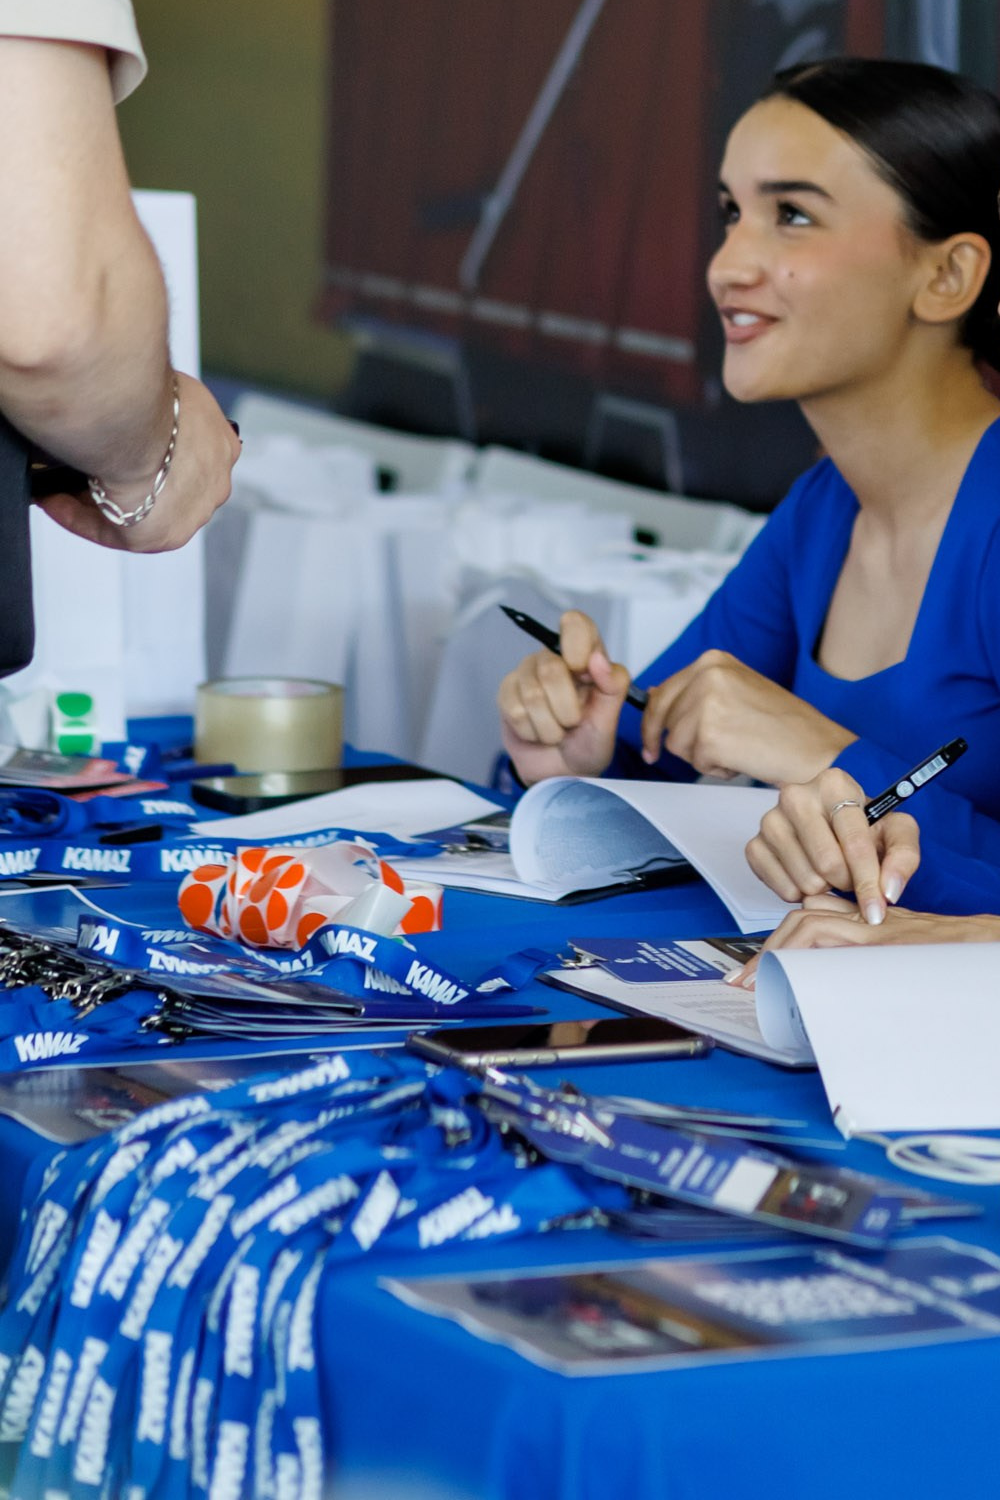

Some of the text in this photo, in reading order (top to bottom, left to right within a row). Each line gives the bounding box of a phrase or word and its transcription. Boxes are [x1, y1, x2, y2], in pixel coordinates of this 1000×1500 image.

[0, 848, 41, 875] AMAZ
[62, 846, 131, 873] KAMAZ
[404, 960, 469, 1005] KAMAZ
[14, 1031, 88, 1062] KAMAZ
